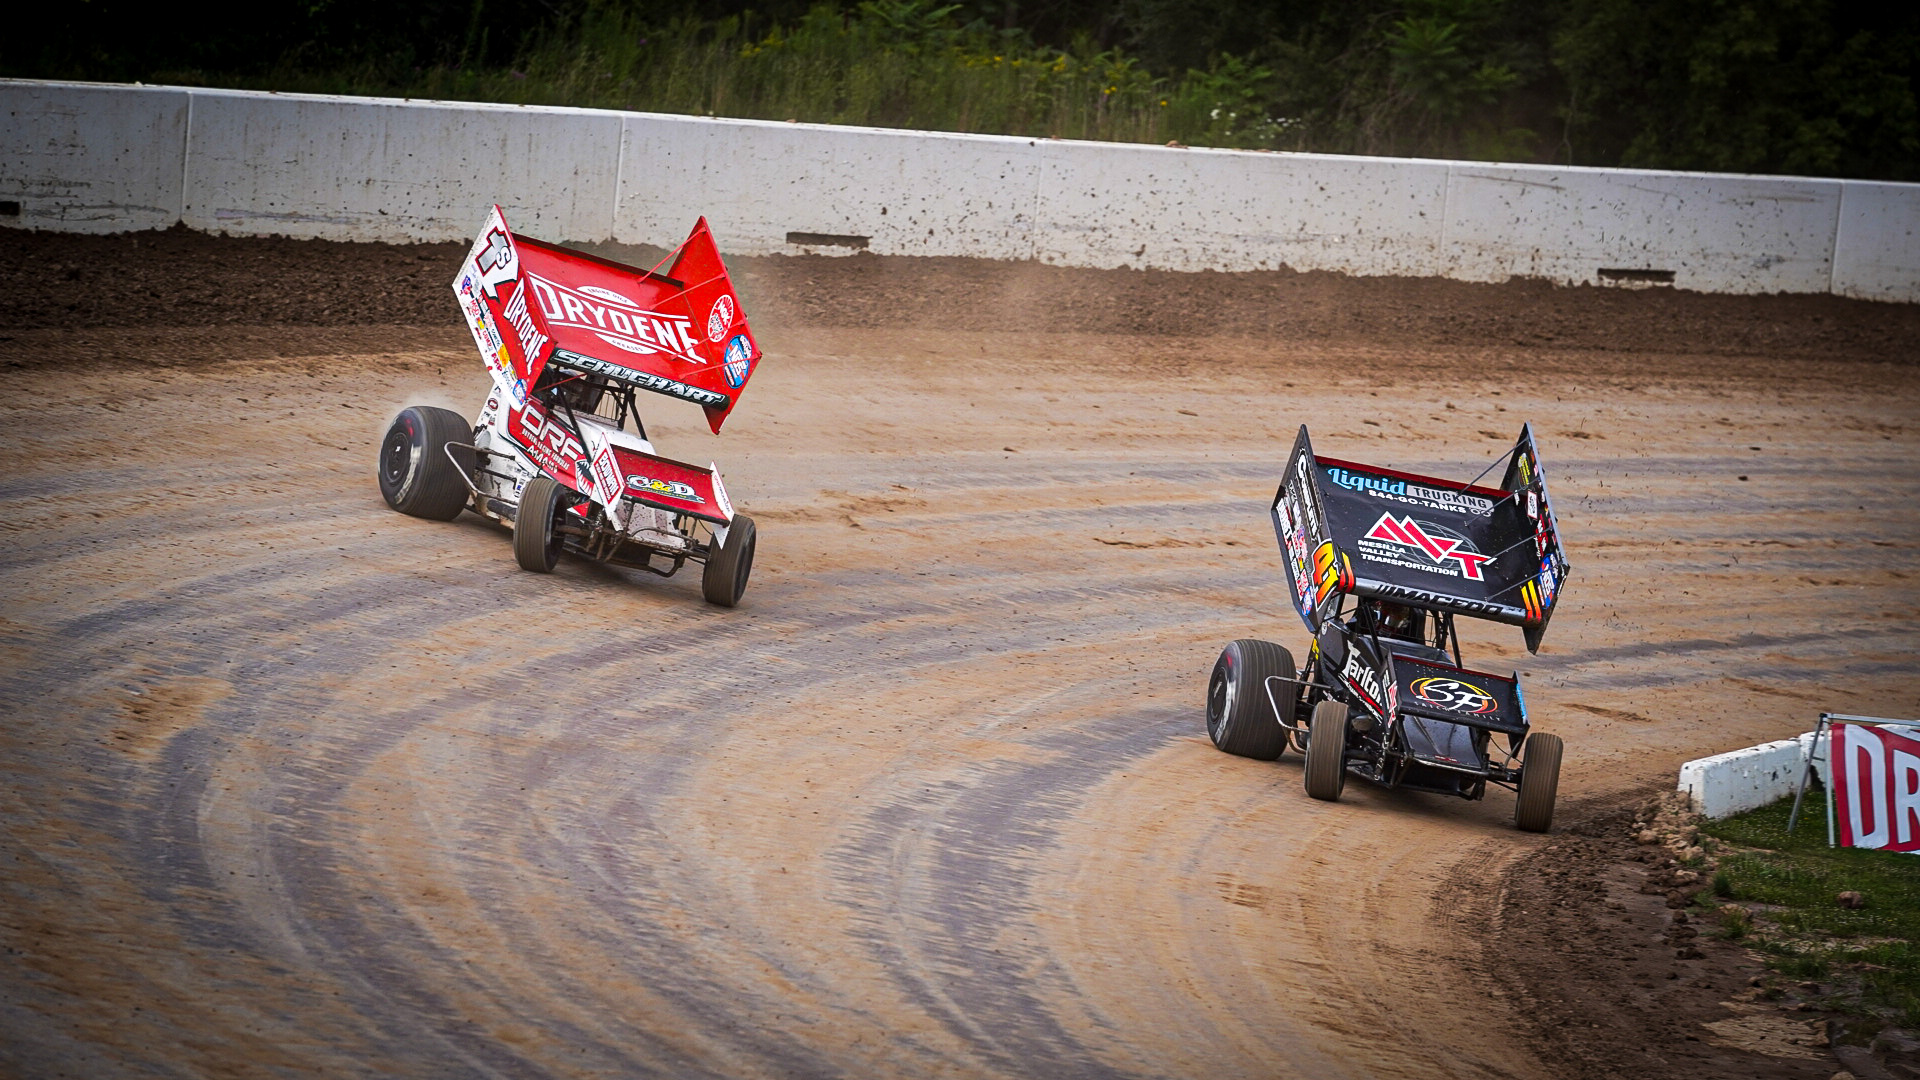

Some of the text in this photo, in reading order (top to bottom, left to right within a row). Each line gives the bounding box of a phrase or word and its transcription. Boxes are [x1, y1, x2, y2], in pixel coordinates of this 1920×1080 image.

[503, 277, 548, 375] DRYDENE
[528, 275, 706, 365] DRYDENE
[520, 404, 584, 460] DRF
[1327, 468, 1405, 496] Liquid
[1413, 487, 1488, 509] TRUCKING
[1368, 489, 1467, 514] 844-GO-TANKS
[1358, 539, 1406, 554] MESILLA
[1358, 546, 1400, 559] VALLEY
[1361, 553, 1459, 577] TRANSPORTATION
[1845, 723, 1920, 850] DR
